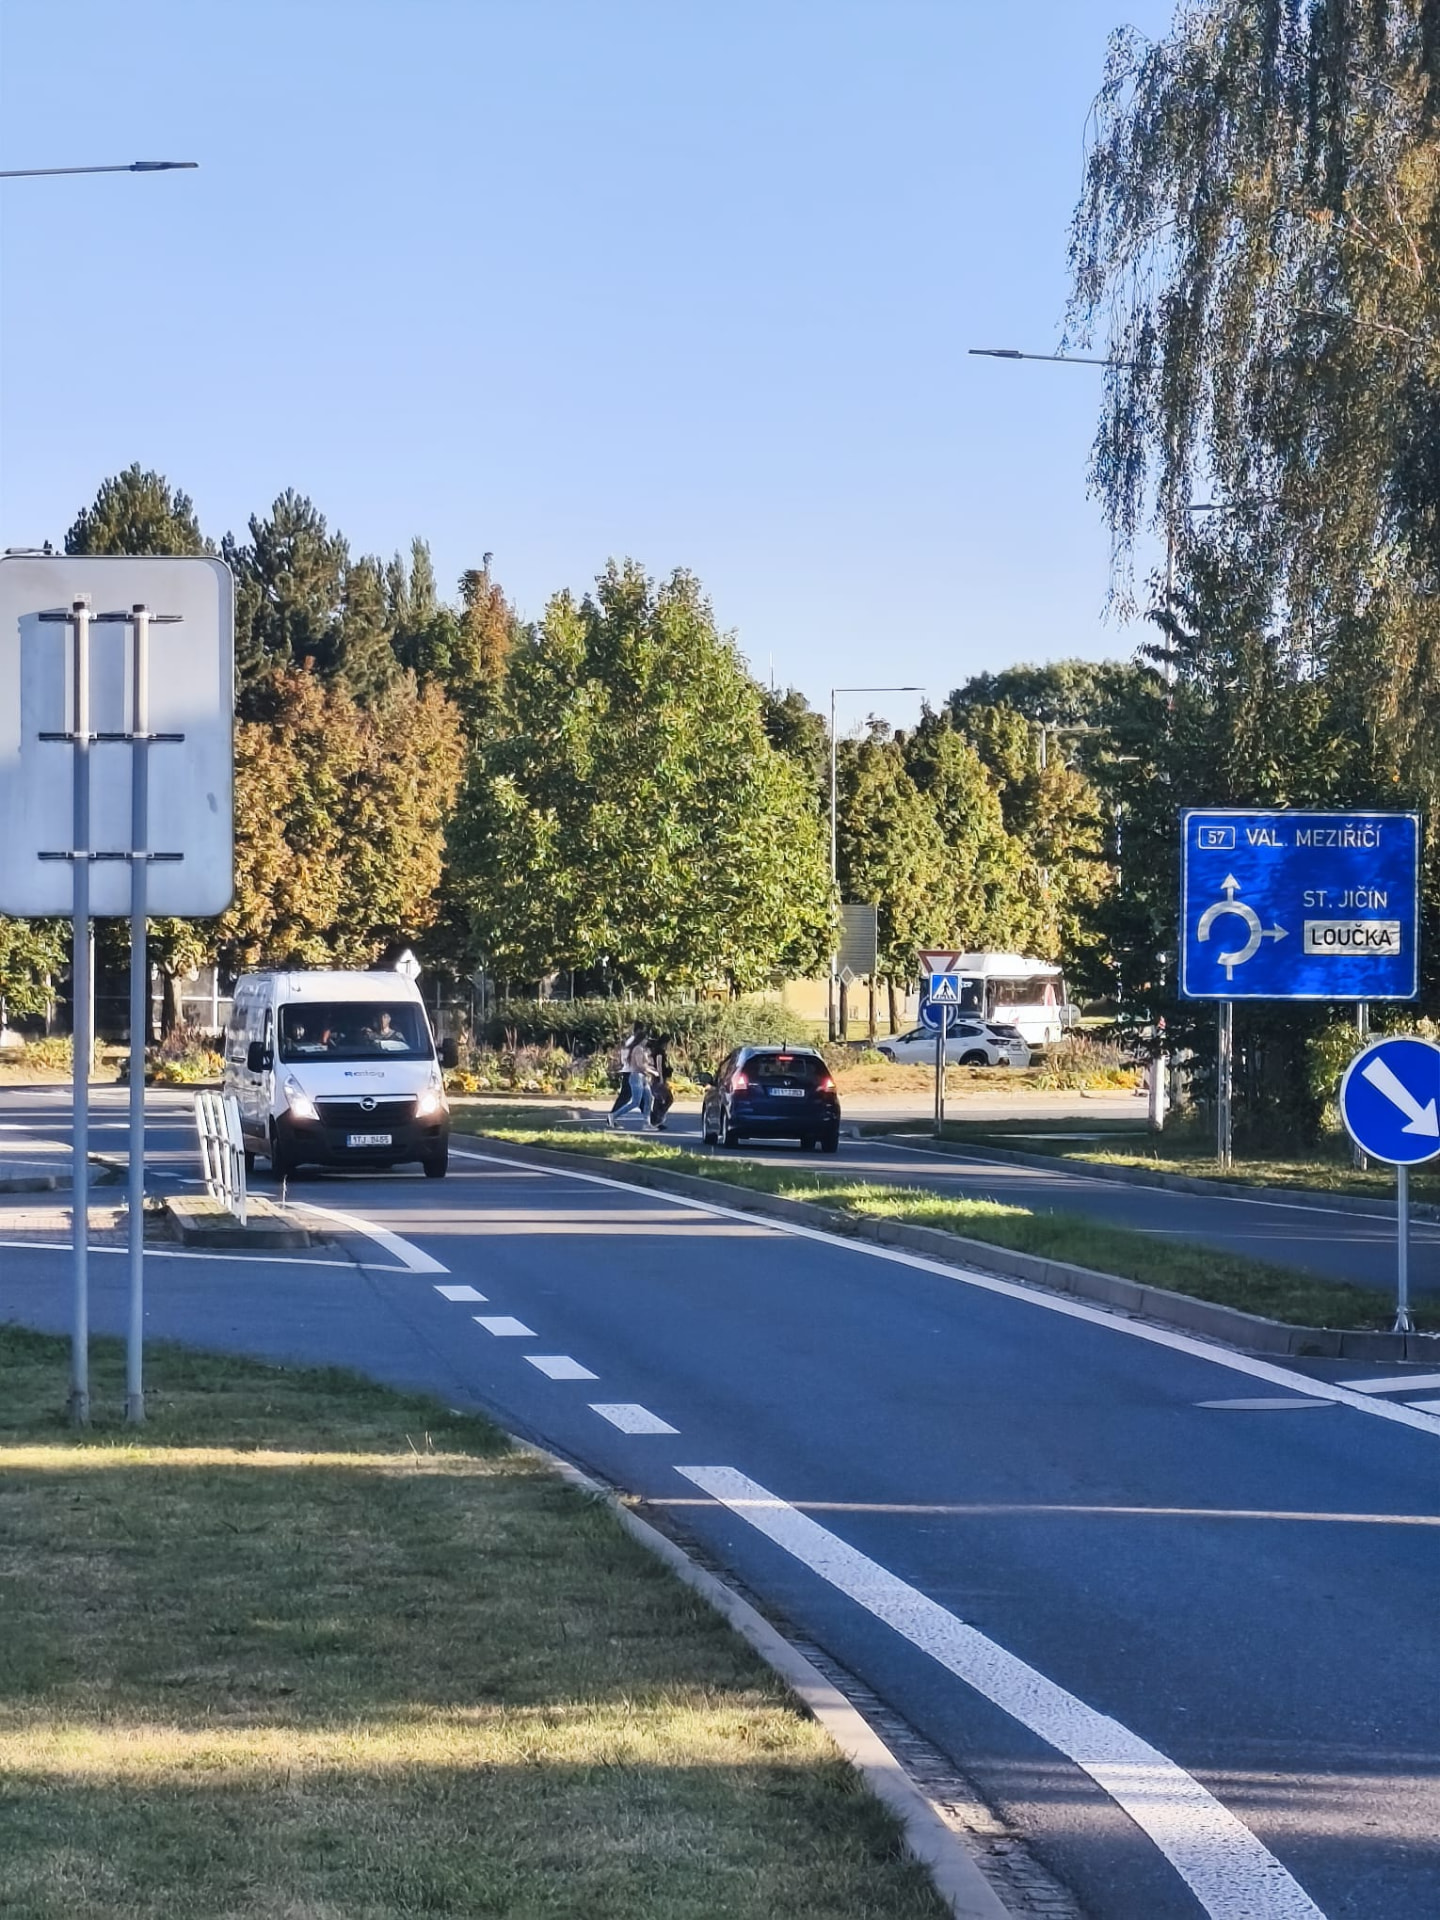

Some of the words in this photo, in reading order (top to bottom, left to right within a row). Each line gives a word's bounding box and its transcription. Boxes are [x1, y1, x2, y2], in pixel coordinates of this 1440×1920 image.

[1207, 830, 1226, 845] 57
[1246, 828, 1288, 847] VAL.
[1296, 823, 1383, 848] MEZIŘÍČÍ
[1303, 890, 1333, 908] ST.
[1338, 885, 1388, 910] JIČÍN
[1311, 923, 1392, 946] LOUČKA
